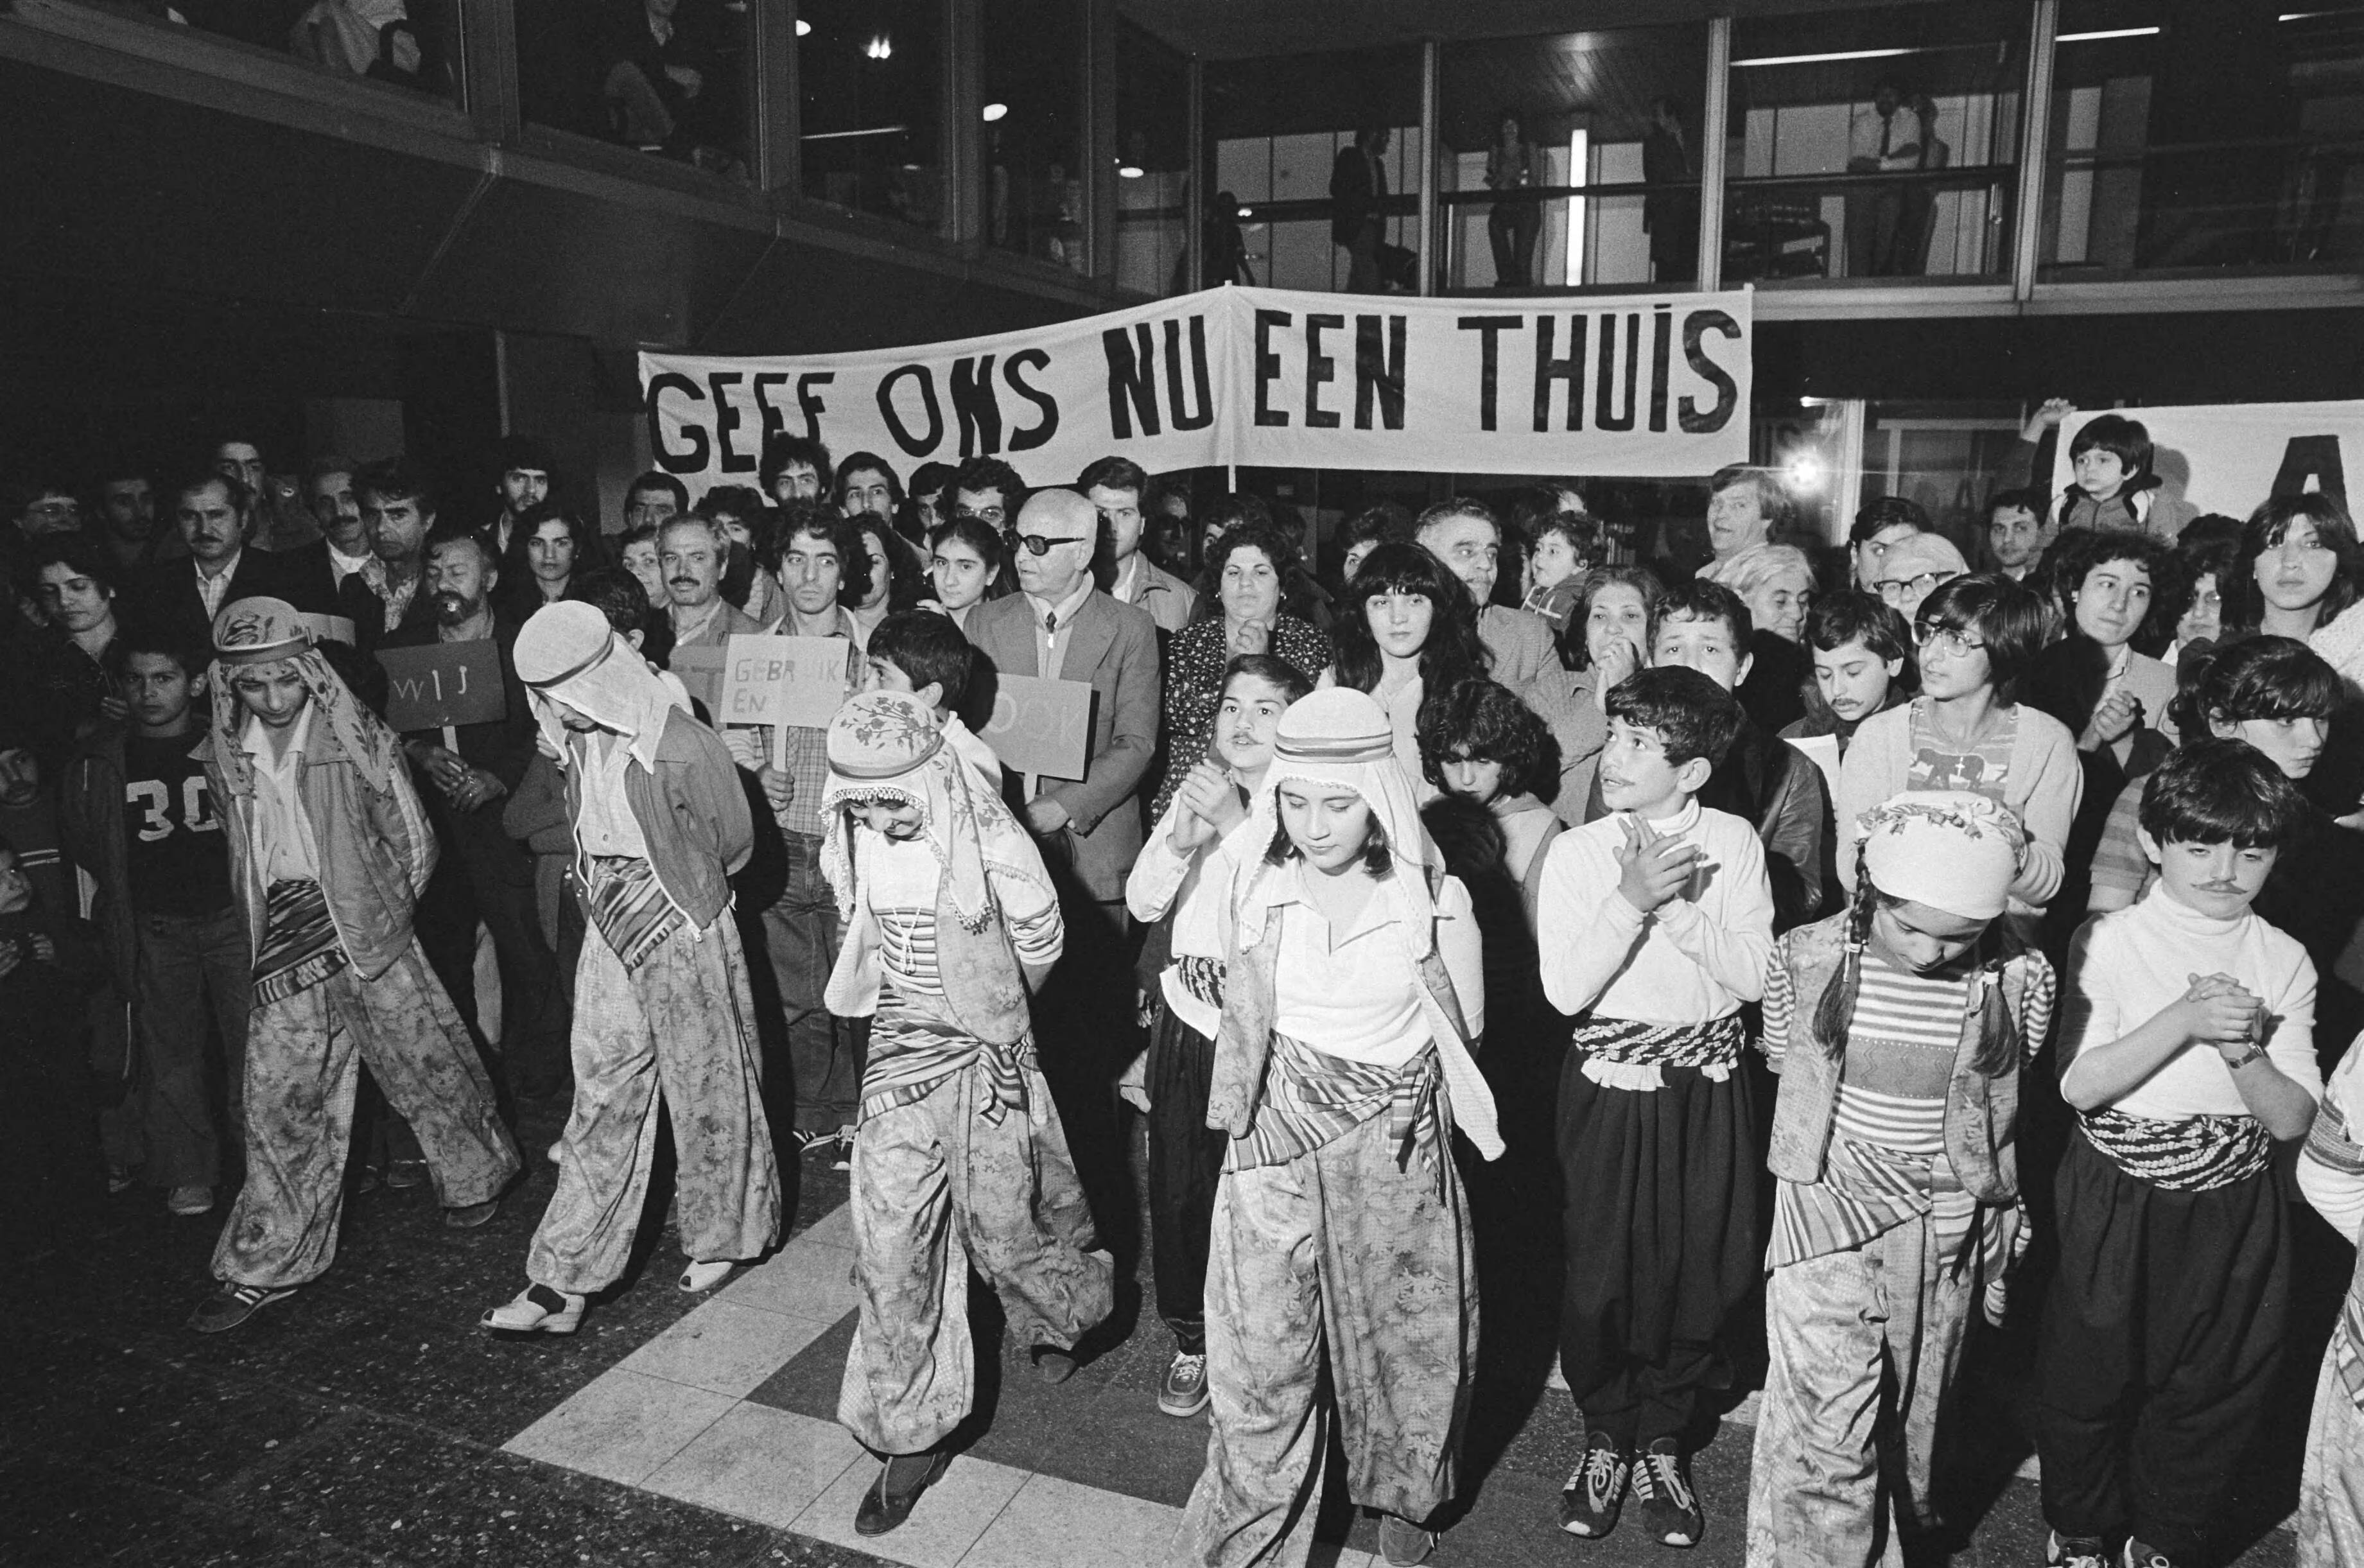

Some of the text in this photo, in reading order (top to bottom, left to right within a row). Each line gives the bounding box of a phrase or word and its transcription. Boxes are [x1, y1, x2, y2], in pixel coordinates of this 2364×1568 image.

[876, 349, 1059, 458] ONS
[1102, 315, 1214, 440] NU
[1255, 309, 1407, 431] EEN
[393, 665, 467, 701] WIJ
[733, 688, 767, 713] EN
